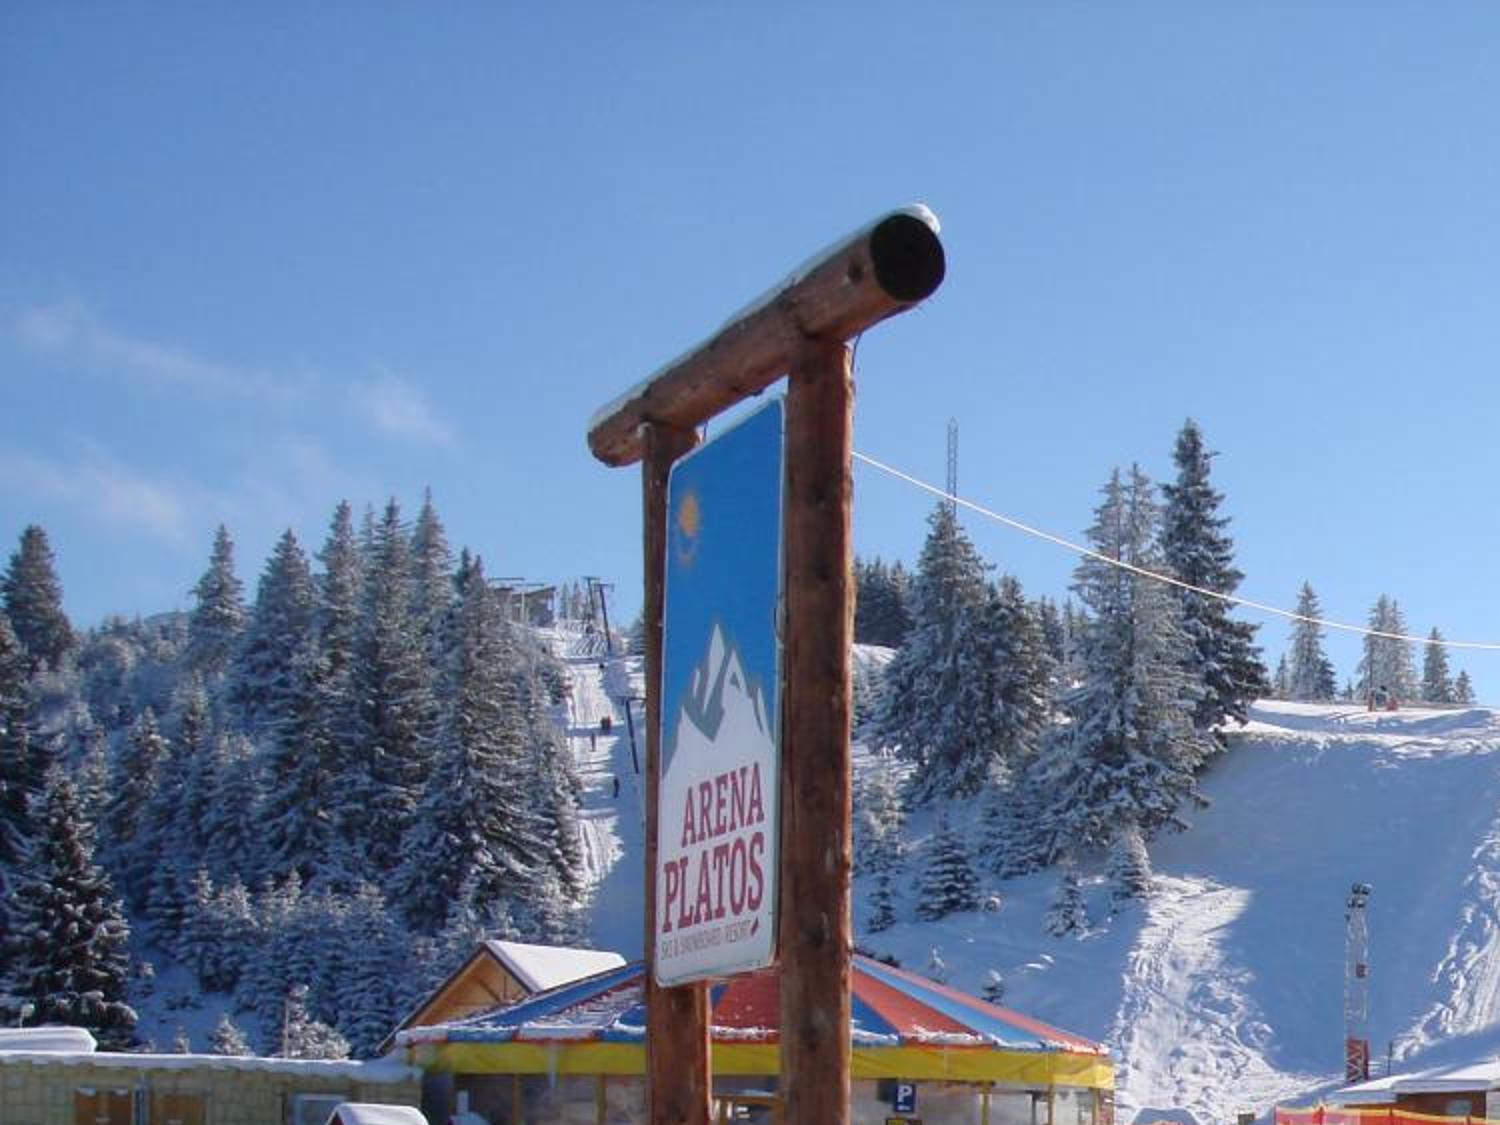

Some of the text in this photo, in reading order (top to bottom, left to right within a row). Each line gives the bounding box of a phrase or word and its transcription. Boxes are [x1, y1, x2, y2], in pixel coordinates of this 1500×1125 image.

[681, 761, 765, 848] ARENA
[661, 831, 765, 933] PLATOS
[897, 1084, 913, 1103] P
